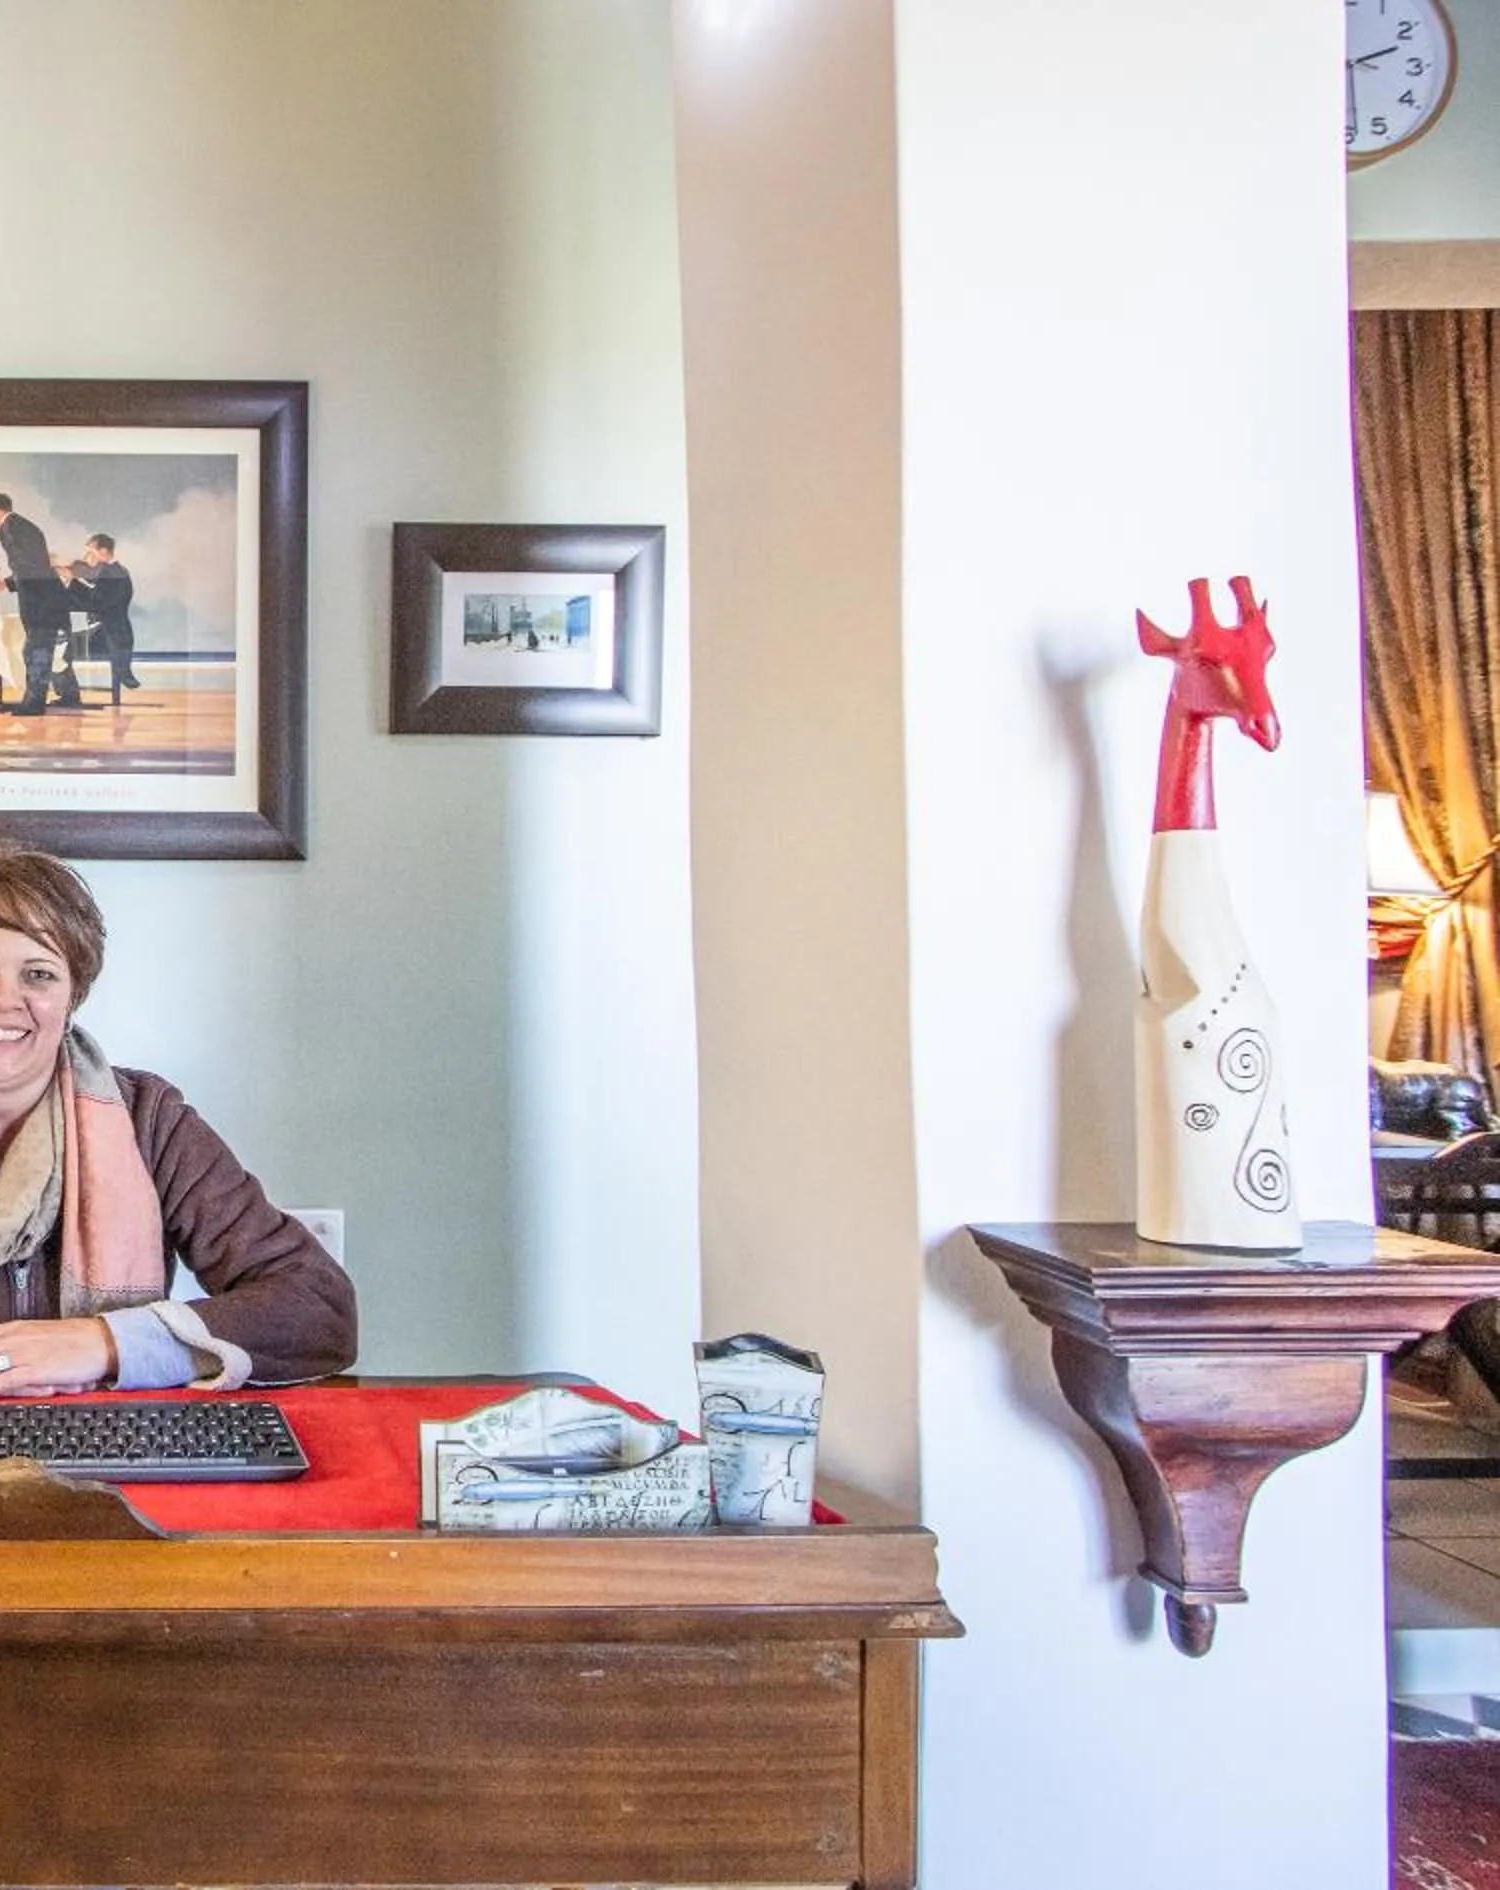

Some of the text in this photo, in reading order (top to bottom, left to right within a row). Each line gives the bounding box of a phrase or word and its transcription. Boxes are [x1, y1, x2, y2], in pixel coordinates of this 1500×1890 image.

[1397, 21, 1413, 40] 2
[1406, 57, 1424, 76] 3
[1397, 89, 1415, 107] 4
[1371, 117, 1388, 135] 5
